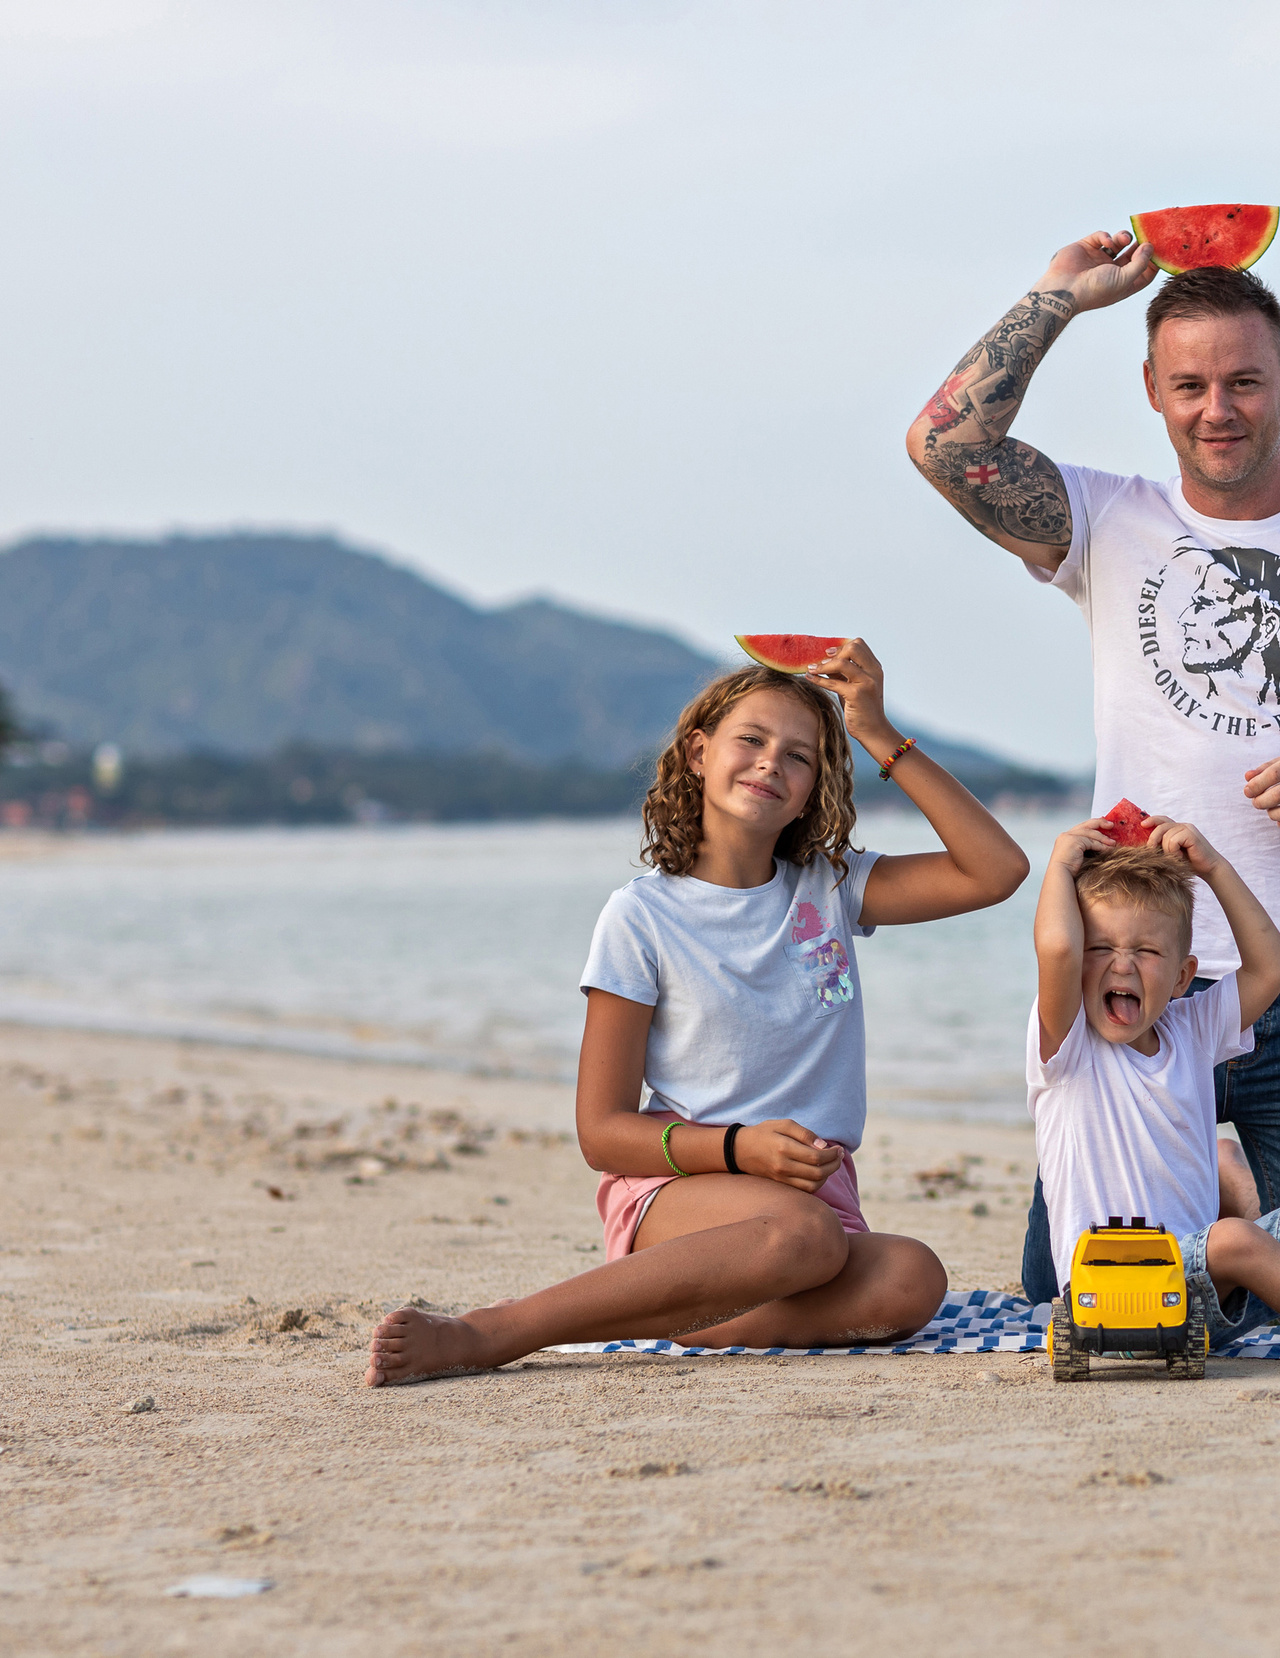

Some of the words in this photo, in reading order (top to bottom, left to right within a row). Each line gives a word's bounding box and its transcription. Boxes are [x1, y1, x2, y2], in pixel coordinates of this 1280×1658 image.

[1138, 577, 1165, 657] DIESEL
[1155, 669, 1202, 718] ONLY
[1211, 712, 1257, 737] THE
